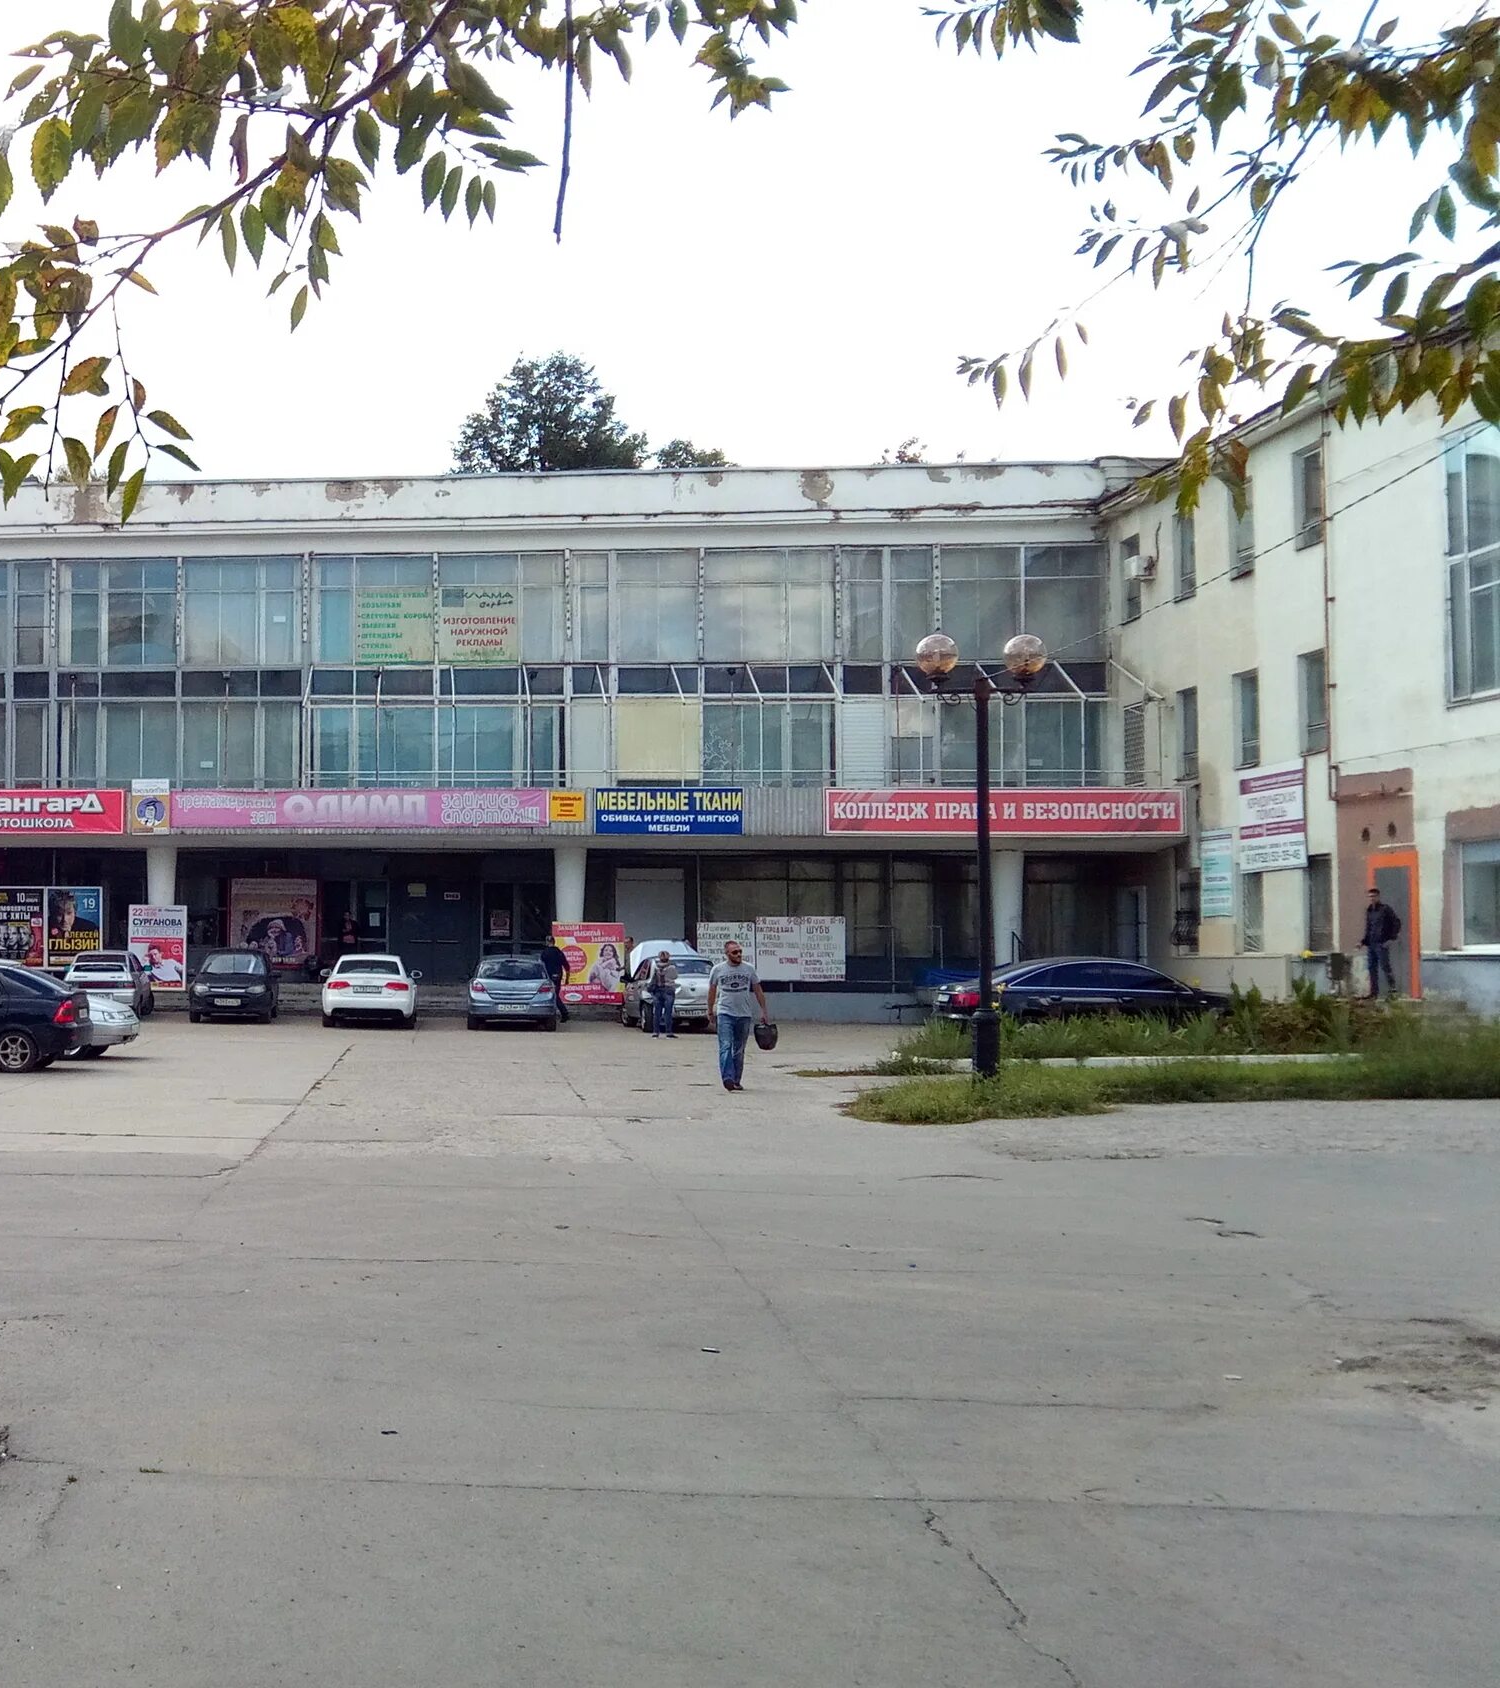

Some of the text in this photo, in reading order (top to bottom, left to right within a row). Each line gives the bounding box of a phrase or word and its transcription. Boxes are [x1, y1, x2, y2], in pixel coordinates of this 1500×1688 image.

[443, 616, 516, 625] ИЗГОТОВЛЕНИЕ
[450, 626, 508, 636] НАРУЖНОЙ
[456, 639, 503, 647] РЕКЛАМЫ
[596, 791, 689, 811] МЕБЕЛЬНЫЕ
[693, 791, 742, 811] ТКАНИ
[833, 802, 929, 821] КОЛЛЕДЖ
[1003, 802, 1017, 820] И
[1022, 802, 1176, 820] БЕЗОПАСНОСТИ
[250, 810, 277, 825] зал
[601, 813, 739, 823] ОБИВКА И РЕМОНТ МЯГКОЙ
[648, 824, 690, 832] МЕБЕЛИ
[16, 892, 26, 903] 10
[82, 898, 96, 909] 19
[132, 908, 143, 917] 22
[132, 918, 183, 926] СУРГАНОВА
[65, 930, 99, 938] АЛЕКСЕЙ
[806, 925, 830, 935] ШУБЫ
[48, 938, 99, 950] ГЛЫЗИН
